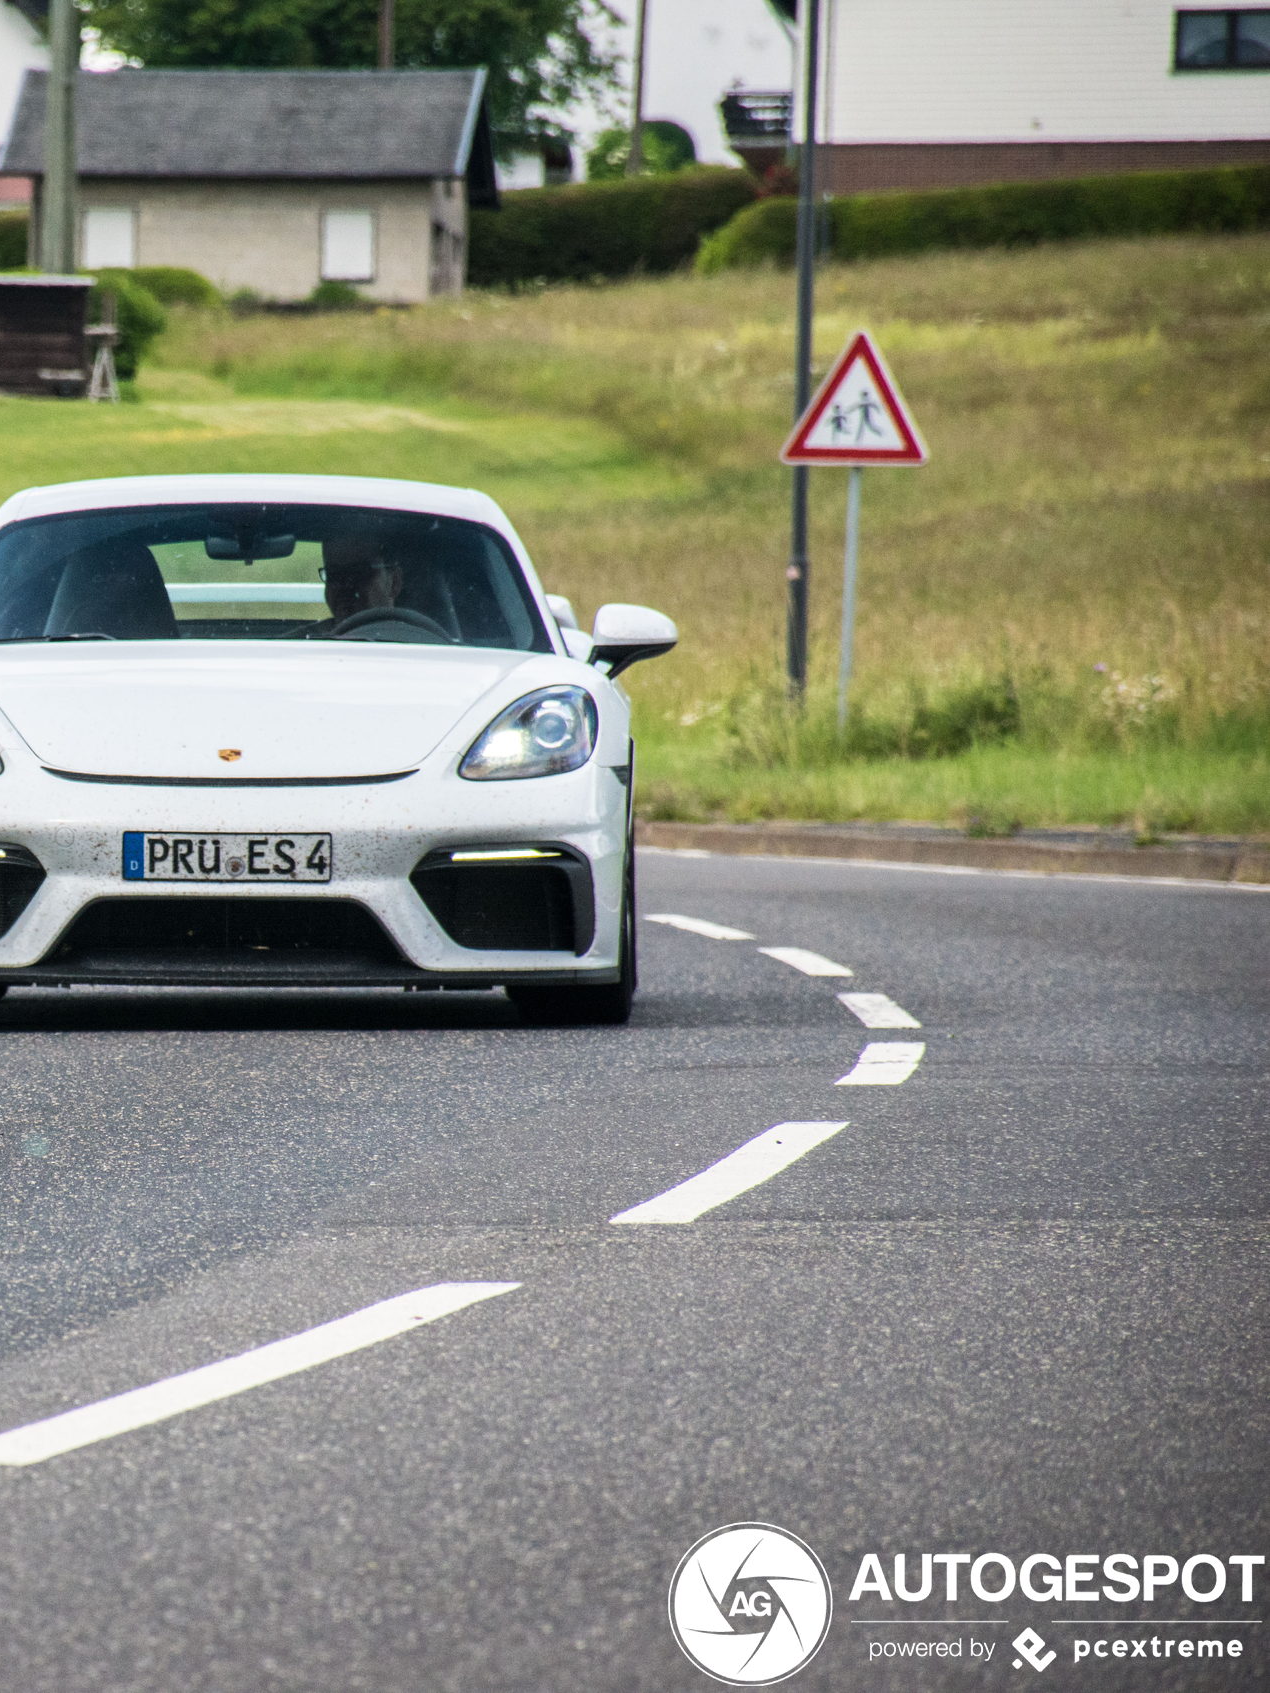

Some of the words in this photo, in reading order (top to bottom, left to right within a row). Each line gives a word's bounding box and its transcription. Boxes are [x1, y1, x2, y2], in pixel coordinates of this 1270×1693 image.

[130, 861, 139, 871] D
[147, 838, 221, 874] PRÜ
[248, 839, 295, 875] ES
